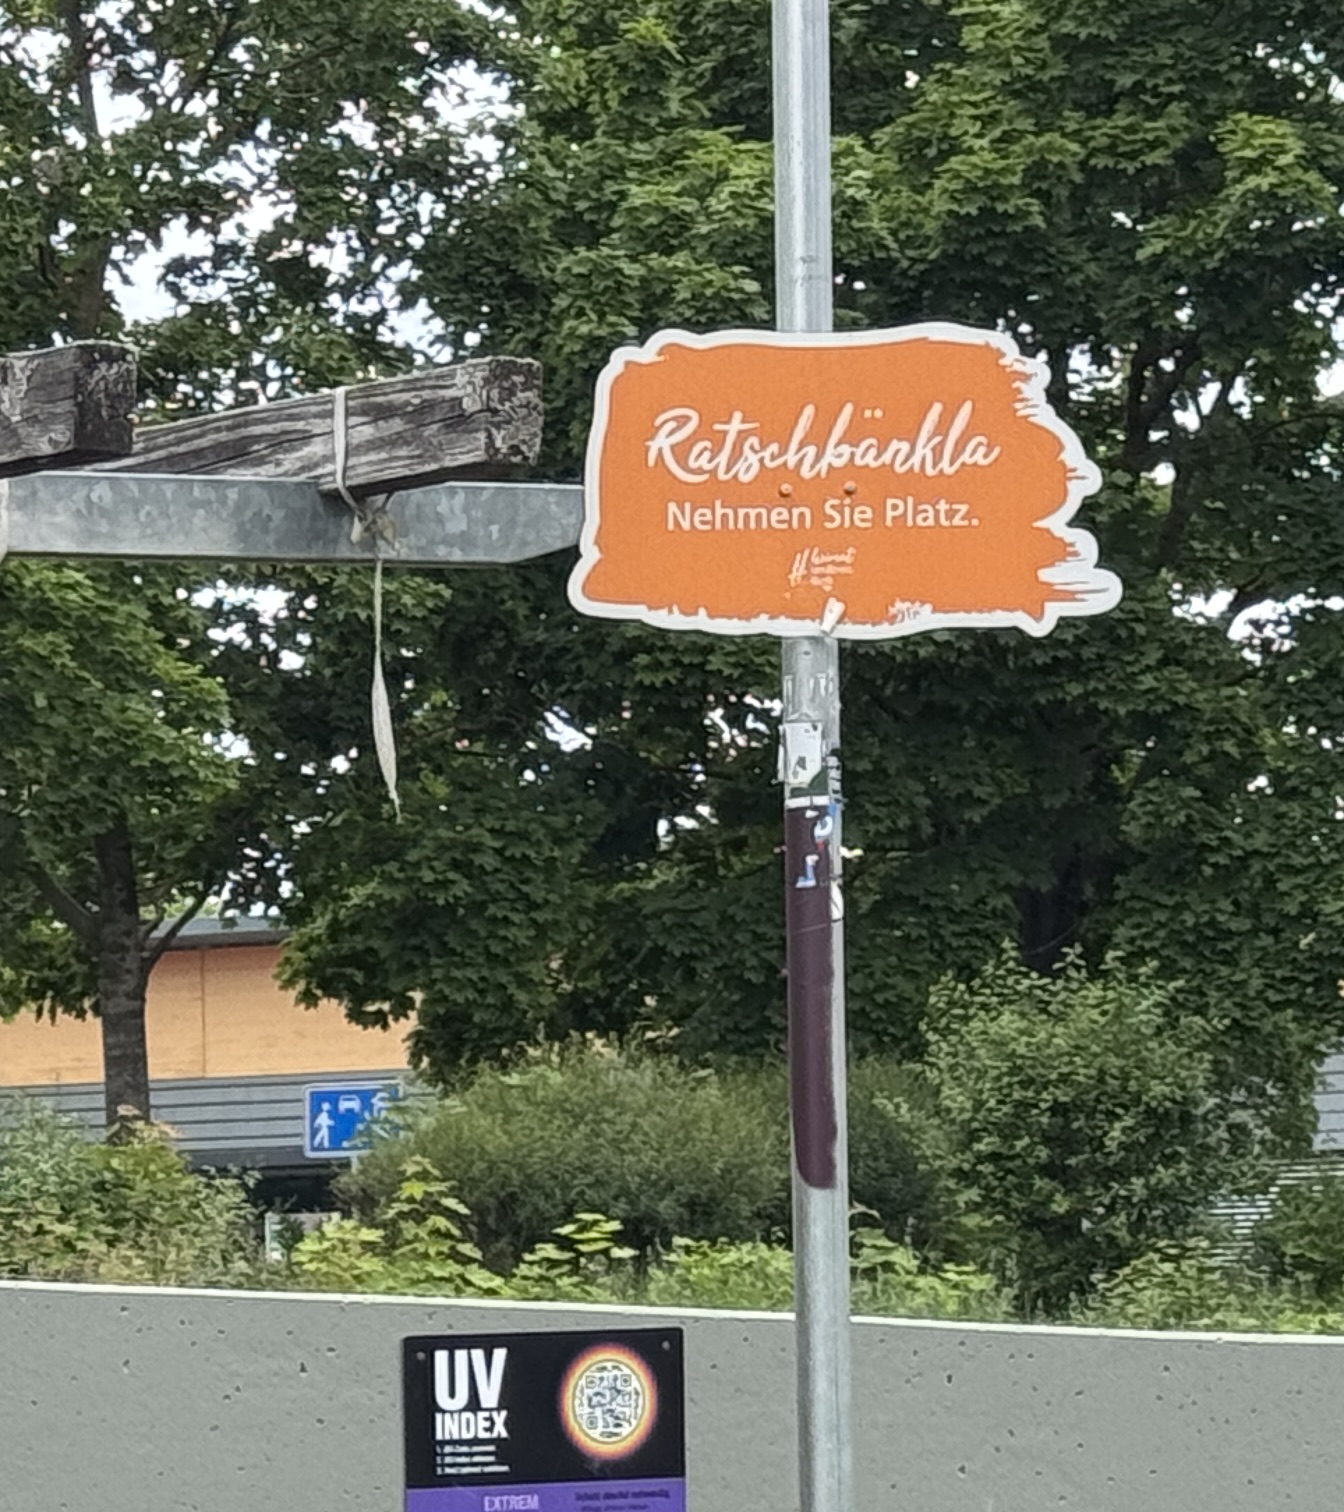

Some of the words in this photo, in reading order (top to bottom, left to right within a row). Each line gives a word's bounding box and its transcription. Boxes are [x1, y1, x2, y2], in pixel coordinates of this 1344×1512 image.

[645, 400, 1002, 485] Ratschbänkla
[666, 500, 812, 532] Nehmen
[823, 498, 875, 531] Sie
[885, 497, 980, 530] Platz.
[434, 1347, 508, 1411] UV
[435, 1410, 510, 1441] INDEX
